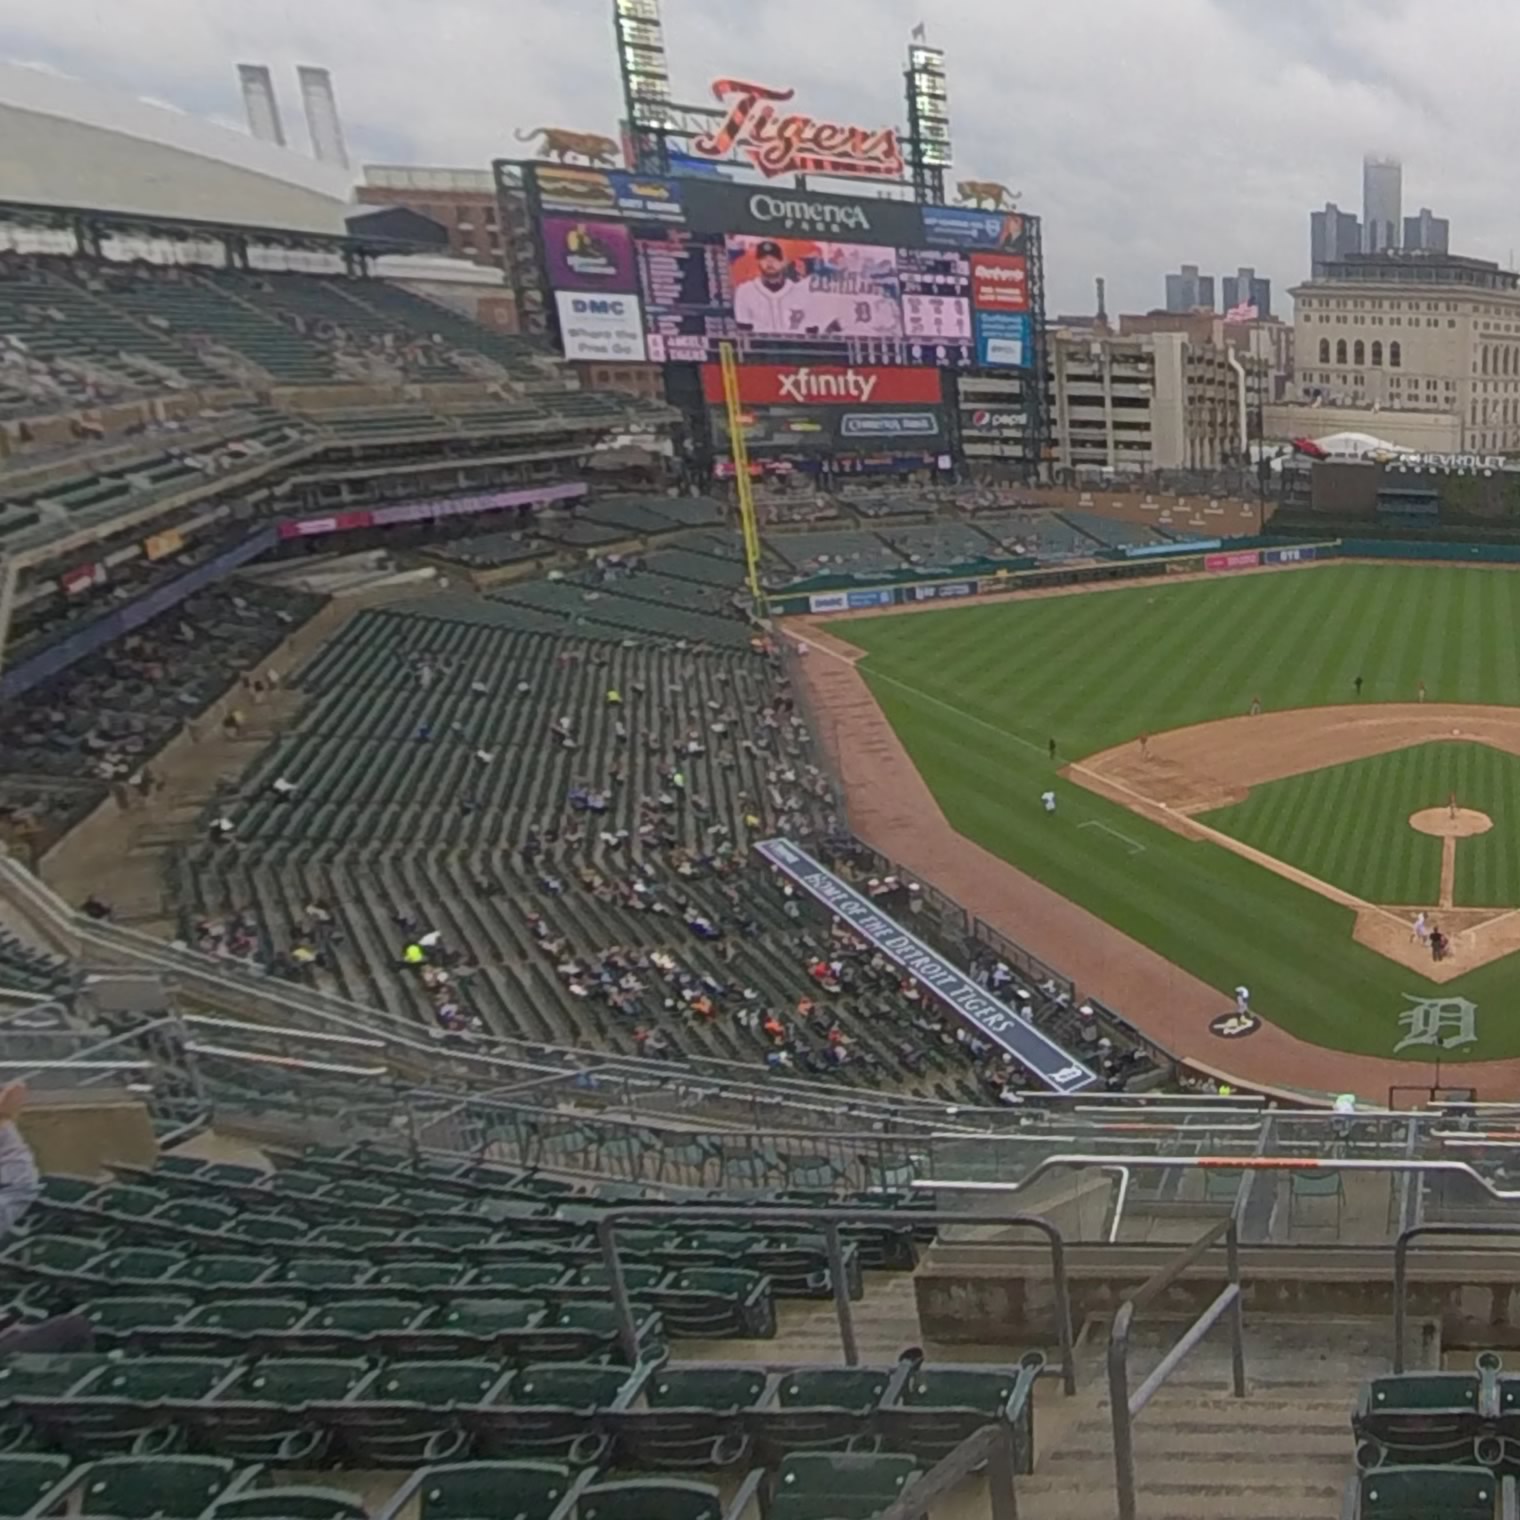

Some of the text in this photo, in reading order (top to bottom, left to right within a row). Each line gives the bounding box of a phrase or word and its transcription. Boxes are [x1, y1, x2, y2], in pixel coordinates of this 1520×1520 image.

[693, 77, 903, 179] Tigers
[571, 299, 625, 316] DMC
[778, 367, 877, 402] xfinity
[804, 873, 1015, 1032] HOME OF THE DETROIT TIGERS
